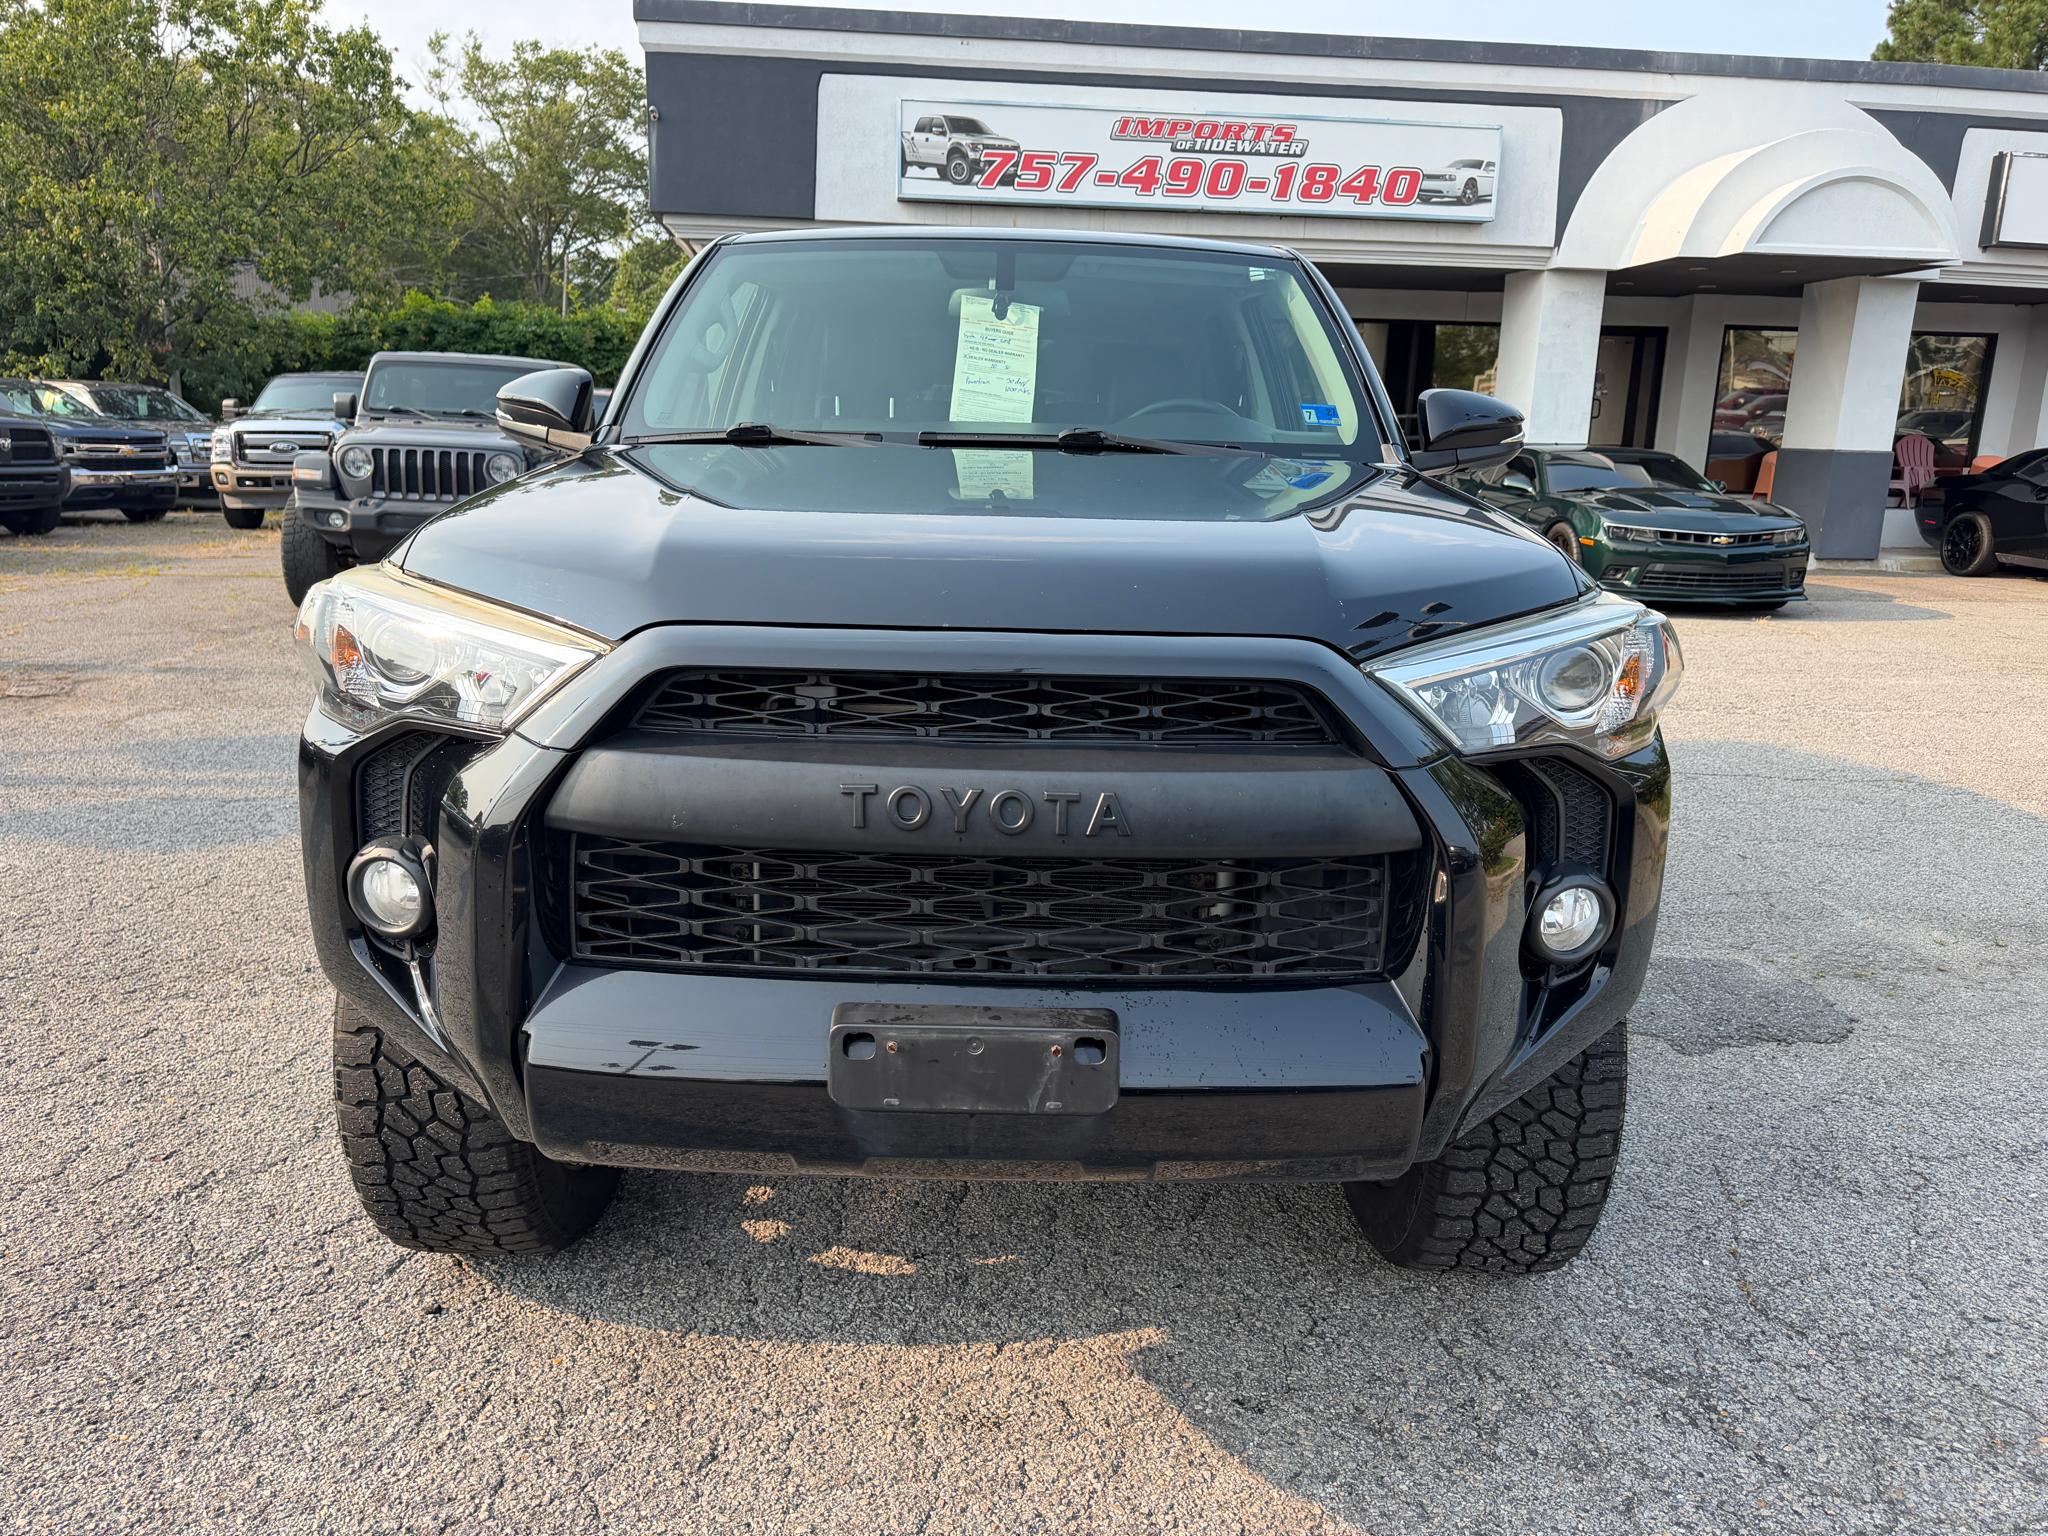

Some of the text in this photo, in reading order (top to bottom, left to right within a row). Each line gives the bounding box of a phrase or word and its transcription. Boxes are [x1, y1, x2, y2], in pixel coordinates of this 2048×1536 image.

[1114, 117, 1297, 143] IMPORTS
[1176, 138, 1304, 155] OF TIDEWATER
[976, 149, 1424, 206] 757-490-1840
[1305, 411, 1312, 420] 7
[840, 783, 1132, 837] TOYOTA
